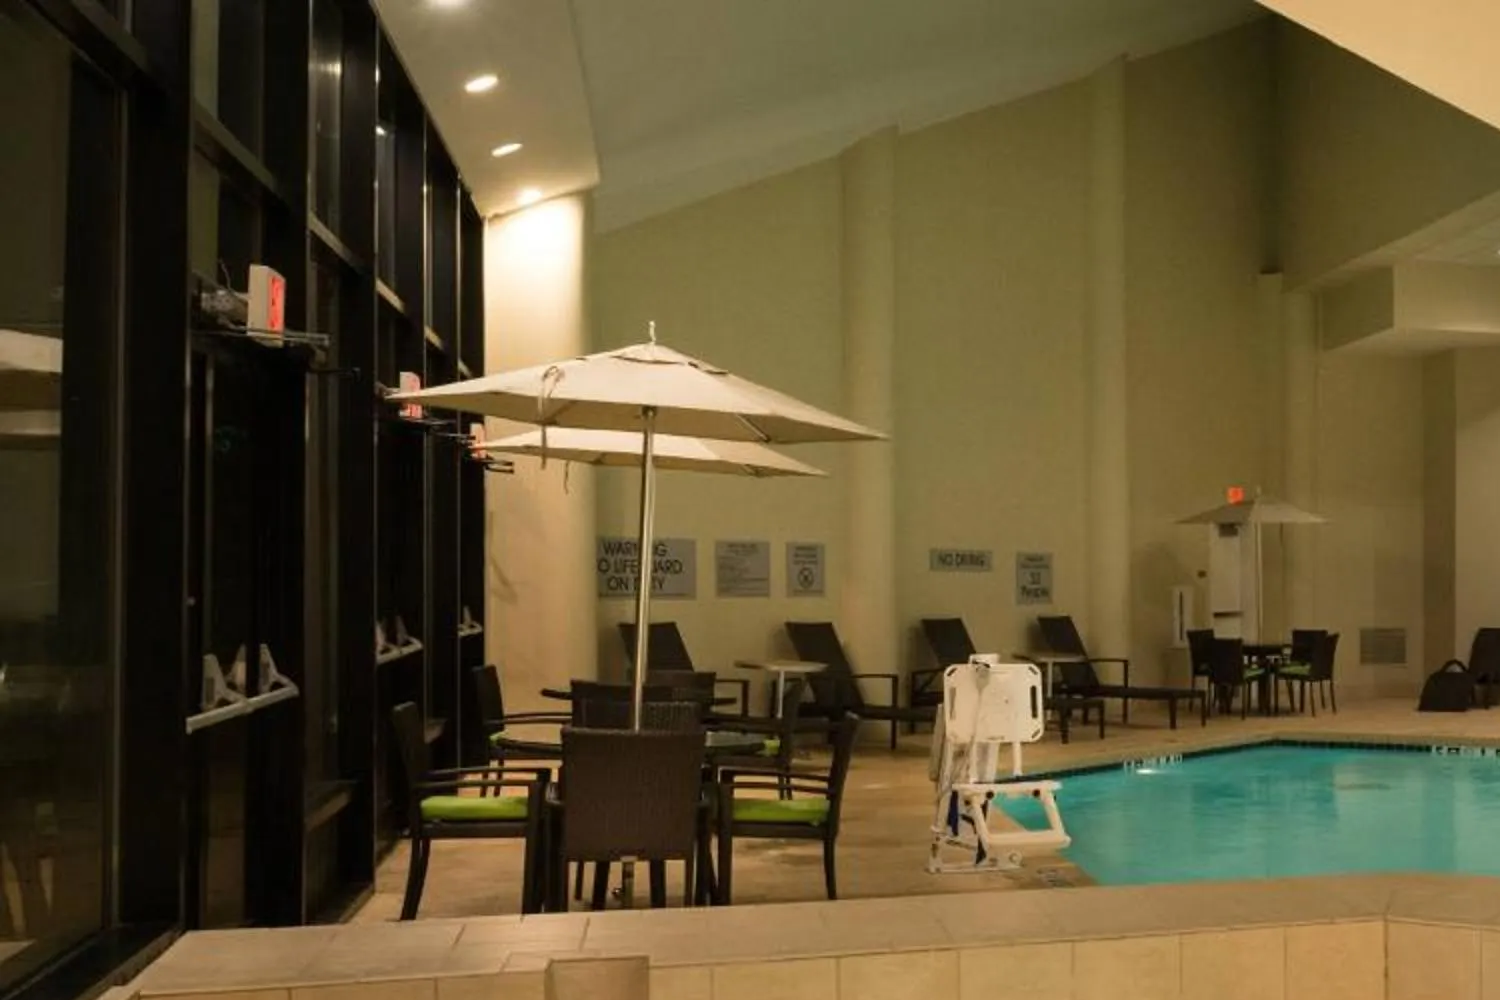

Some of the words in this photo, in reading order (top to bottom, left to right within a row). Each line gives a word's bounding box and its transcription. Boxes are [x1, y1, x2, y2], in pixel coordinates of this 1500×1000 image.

[603, 541, 667, 556] WARG
[614, 559, 683, 574] LIFEARD
[607, 576, 629, 590] ON
[634, 577, 666, 590] DTY
